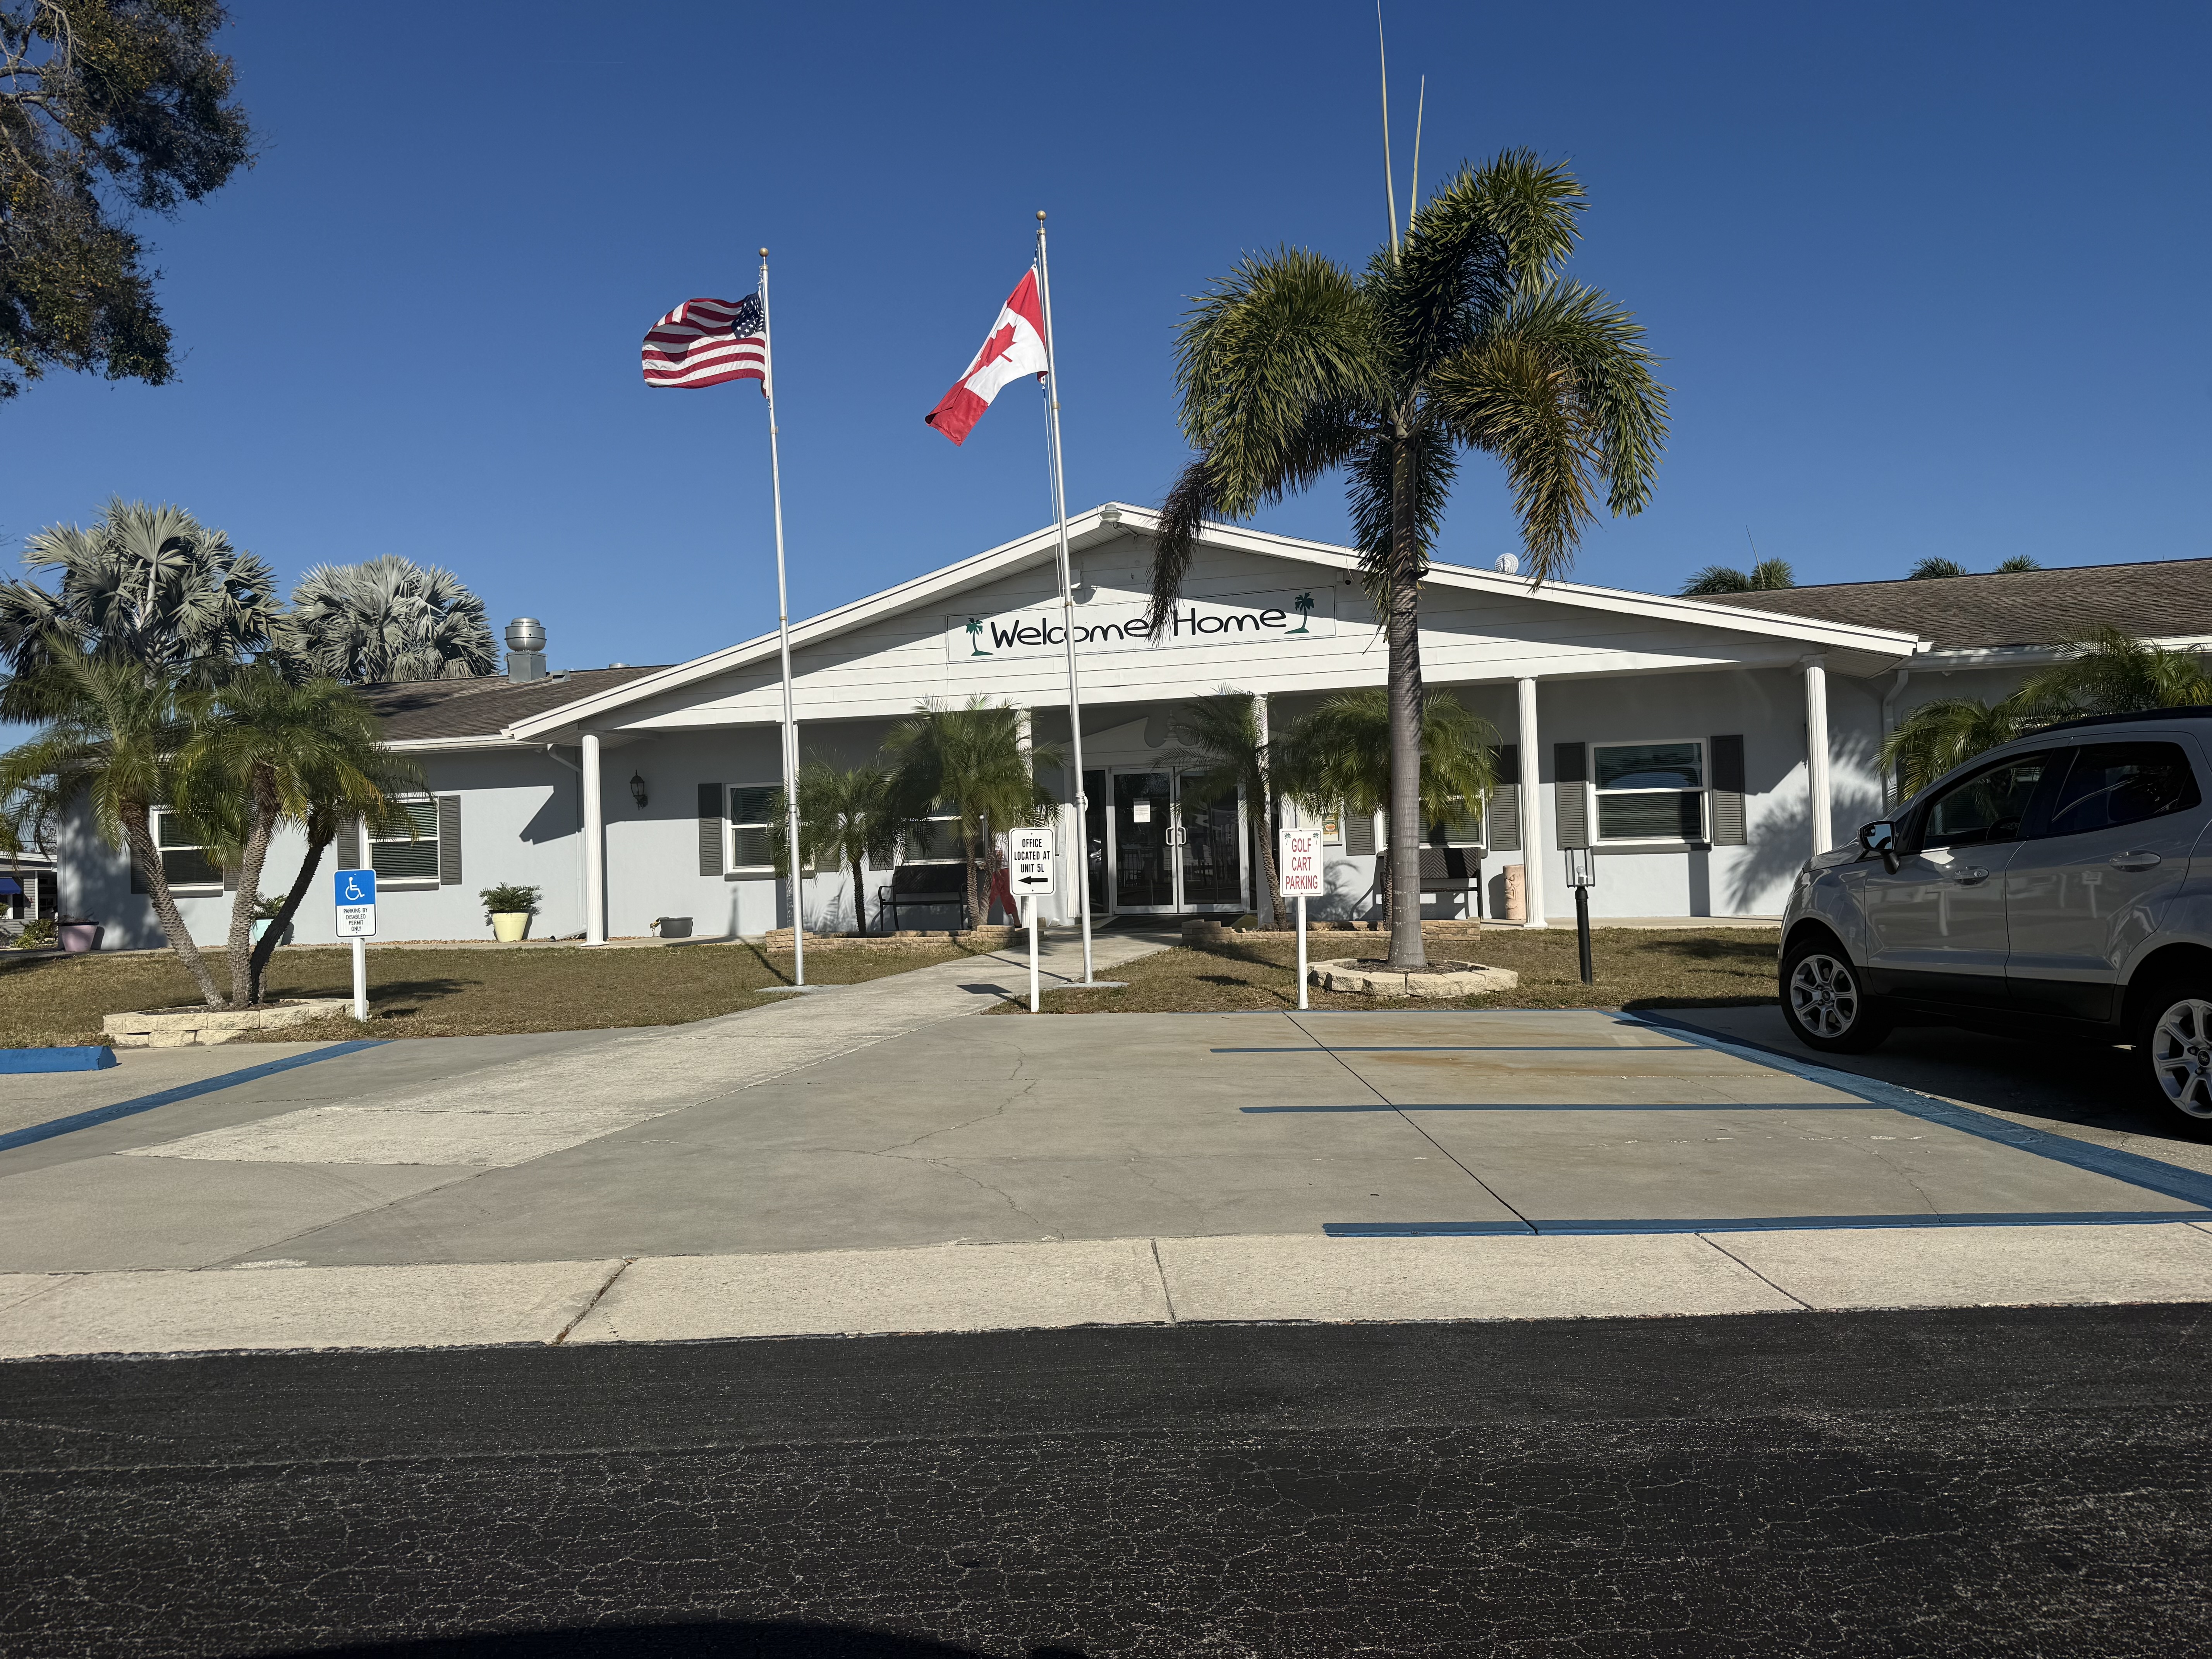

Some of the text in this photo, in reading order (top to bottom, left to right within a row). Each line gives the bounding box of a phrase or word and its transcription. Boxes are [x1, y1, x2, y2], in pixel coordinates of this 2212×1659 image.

[991, 608, 1286, 648] Welcome Home
[1022, 838, 1042, 848] OFFICE
[1292, 838, 1311, 852] GOLF
[1014, 851, 1050, 860] LOCATED AT
[1021, 864, 1044, 872] UNIT 5L
[1292, 857, 1312, 871] CART
[1286, 875, 1318, 890] PARKING
